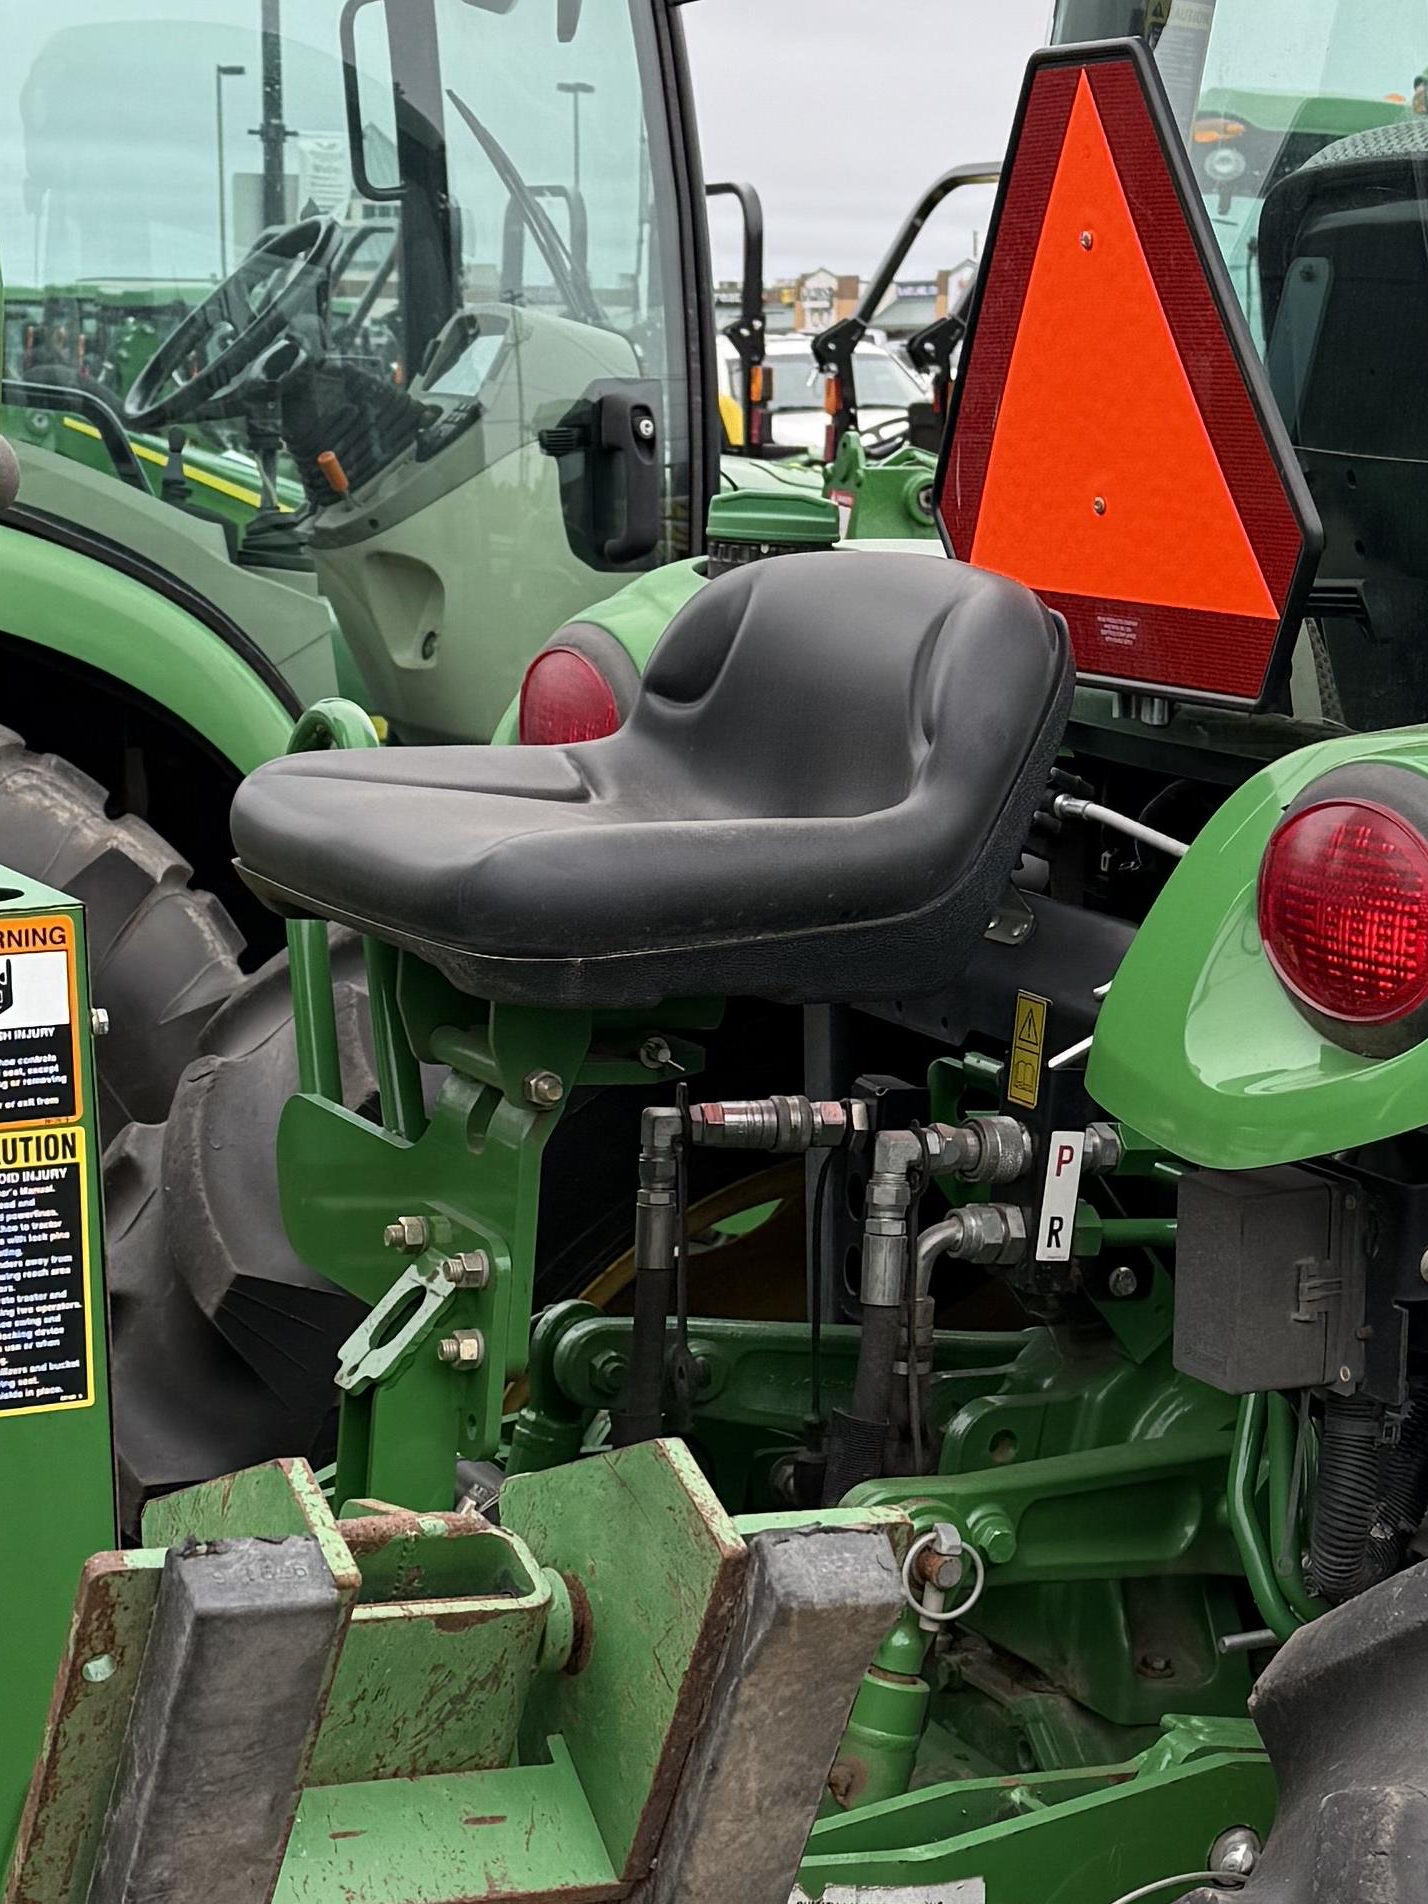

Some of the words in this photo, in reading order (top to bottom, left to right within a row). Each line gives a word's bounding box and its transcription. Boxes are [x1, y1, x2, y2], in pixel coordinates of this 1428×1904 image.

[14, 1027, 55, 1040] INJURY
[10, 1079, 21, 1087] or
[23, 1075, 67, 1086] removing
[5, 1101, 15, 1109] or
[1055, 1145, 1074, 1177] P
[22, 1167, 68, 1183] INJURY
[18, 1198, 36, 1208] and
[20, 1223, 30, 1231] to
[1047, 1216, 1064, 1248] R
